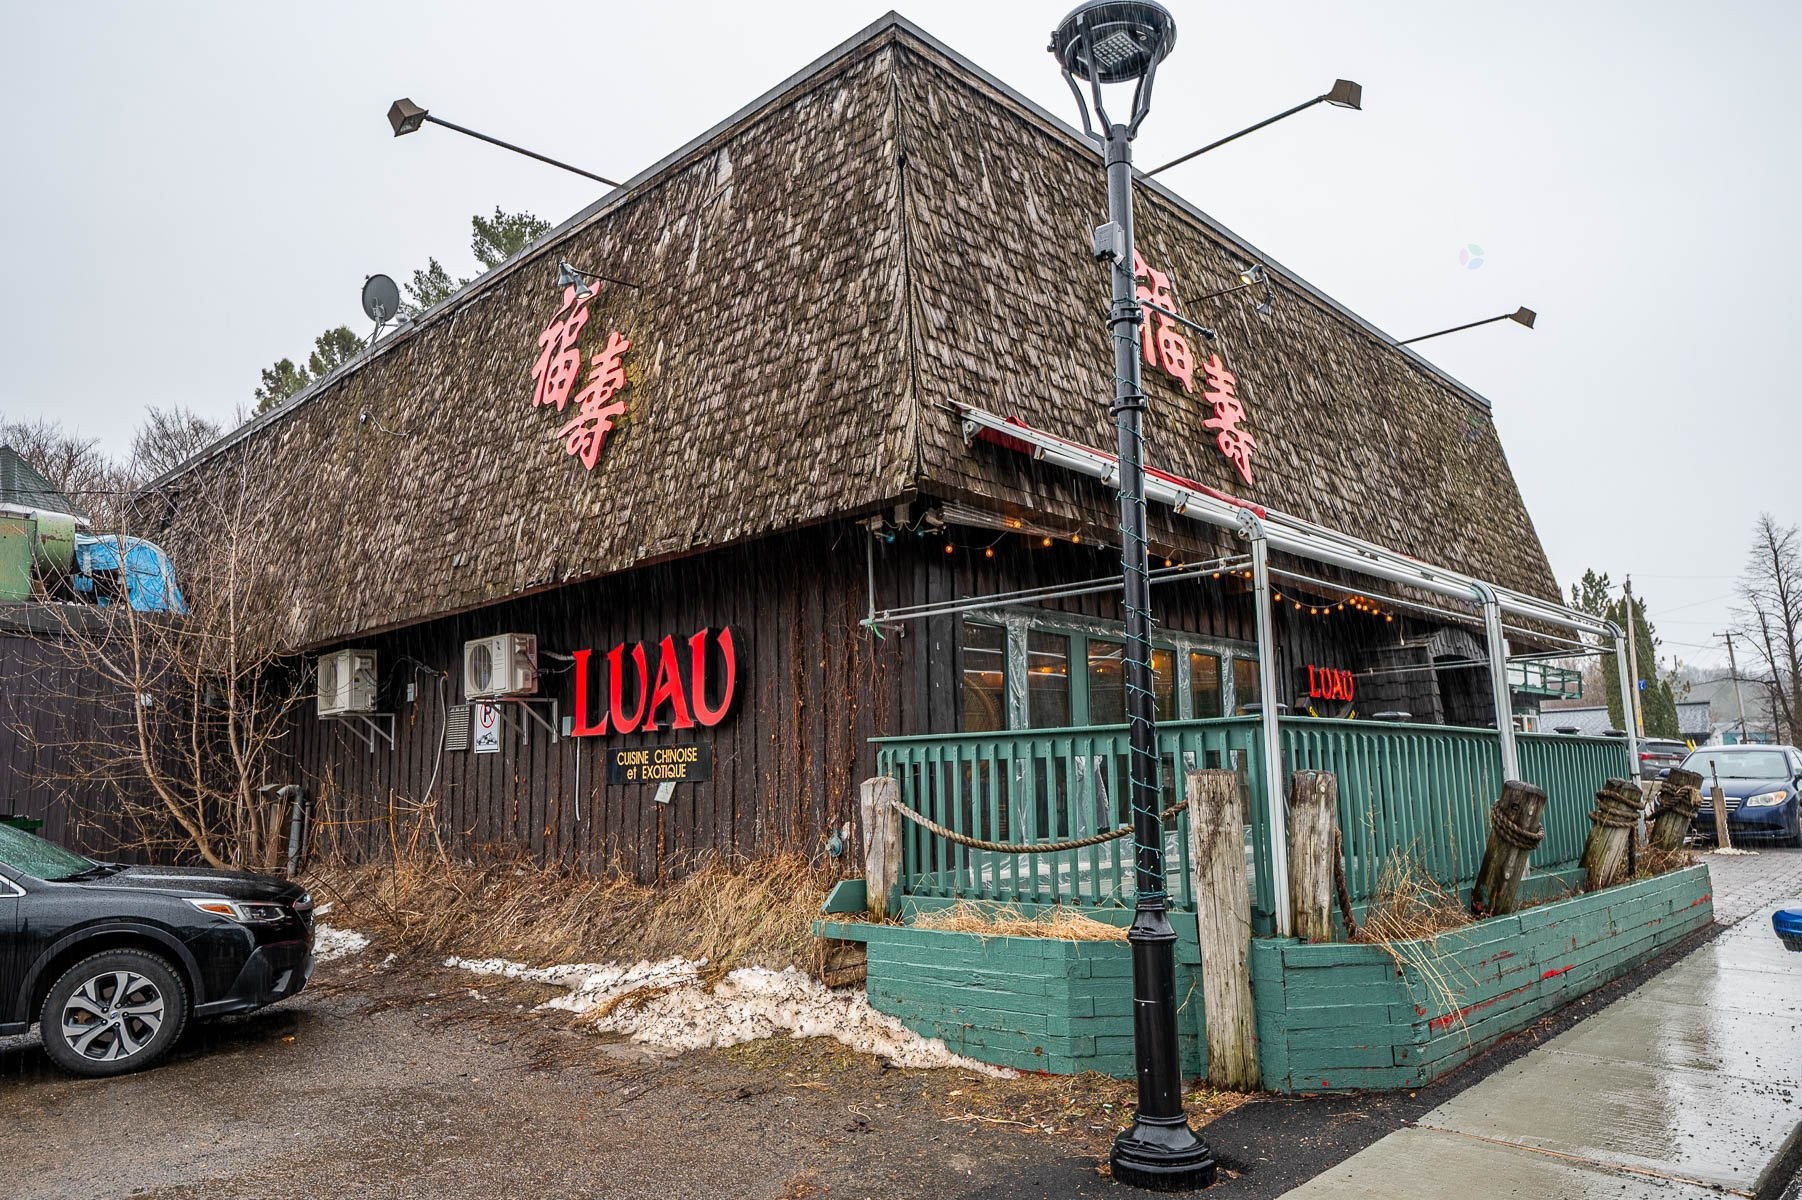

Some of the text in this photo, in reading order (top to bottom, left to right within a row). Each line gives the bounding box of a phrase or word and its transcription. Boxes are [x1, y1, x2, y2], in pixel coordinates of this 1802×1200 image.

[571, 626, 736, 737] LUAU
[1308, 664, 1354, 702] LUAU
[617, 747, 698, 766] CUISINE CHINOISE
[626, 763, 687, 780] et EXOTIQUE
